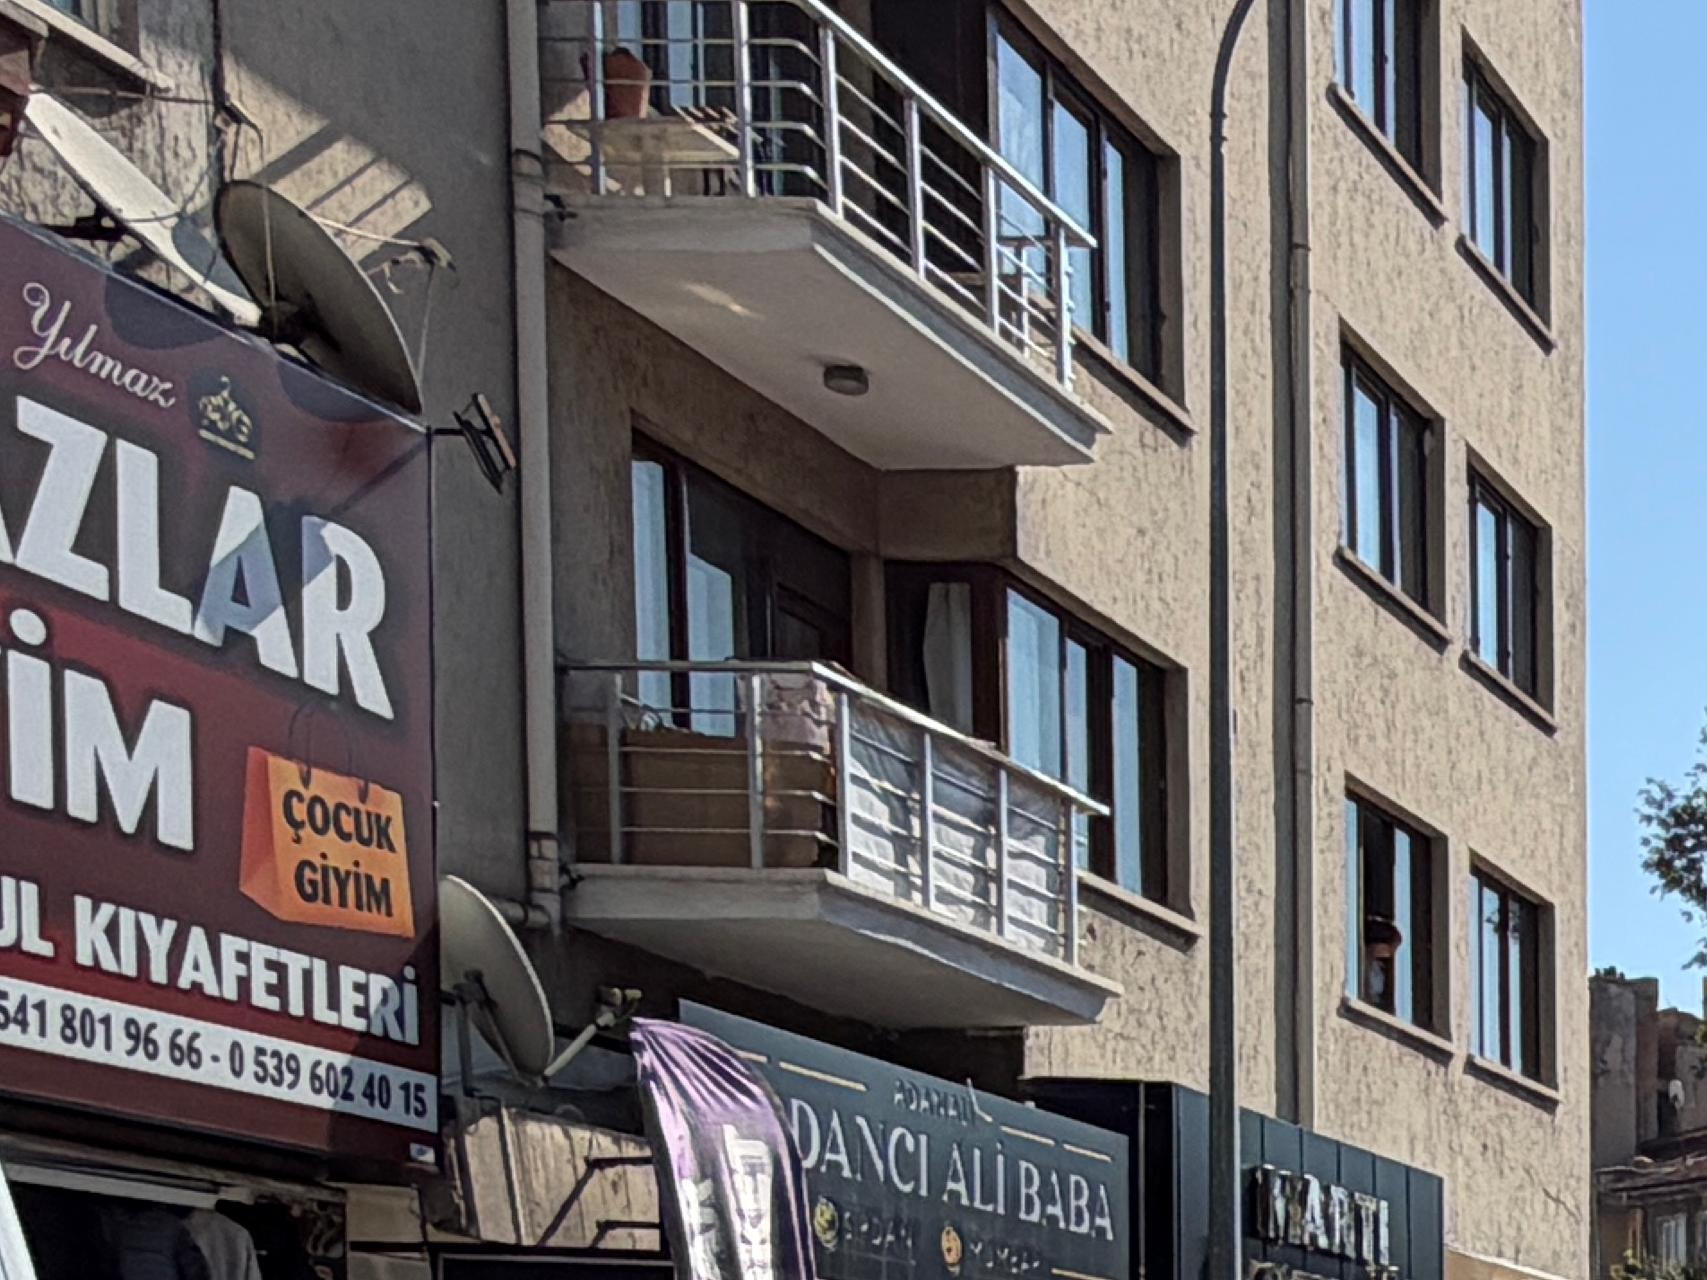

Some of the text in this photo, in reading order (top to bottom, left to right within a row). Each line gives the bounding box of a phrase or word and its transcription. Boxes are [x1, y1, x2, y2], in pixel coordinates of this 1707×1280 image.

[12, 282, 176, 408] Yılmaz
[0, 394, 395, 721] ZLAR
[0, 607, 194, 852] İM
[282, 788, 397, 854] ÇOCUK
[294, 852, 394, 918] GİYİM
[74, 894, 420, 1046] KIYAFETLERİ
[60, 1003, 113, 1052] 801
[124, 1018, 161, 1061] 96
[169, 1029, 202, 1069] 66
[229, 1040, 244, 1078] 0
[253, 1049, 301, 1090] 539
[309, 1060, 355, 1102] 602
[361, 1073, 391, 1110] 40
[399, 1081, 427, 1119] 15
[791, 1097, 1115, 1242] DANCI ALİ BABA
